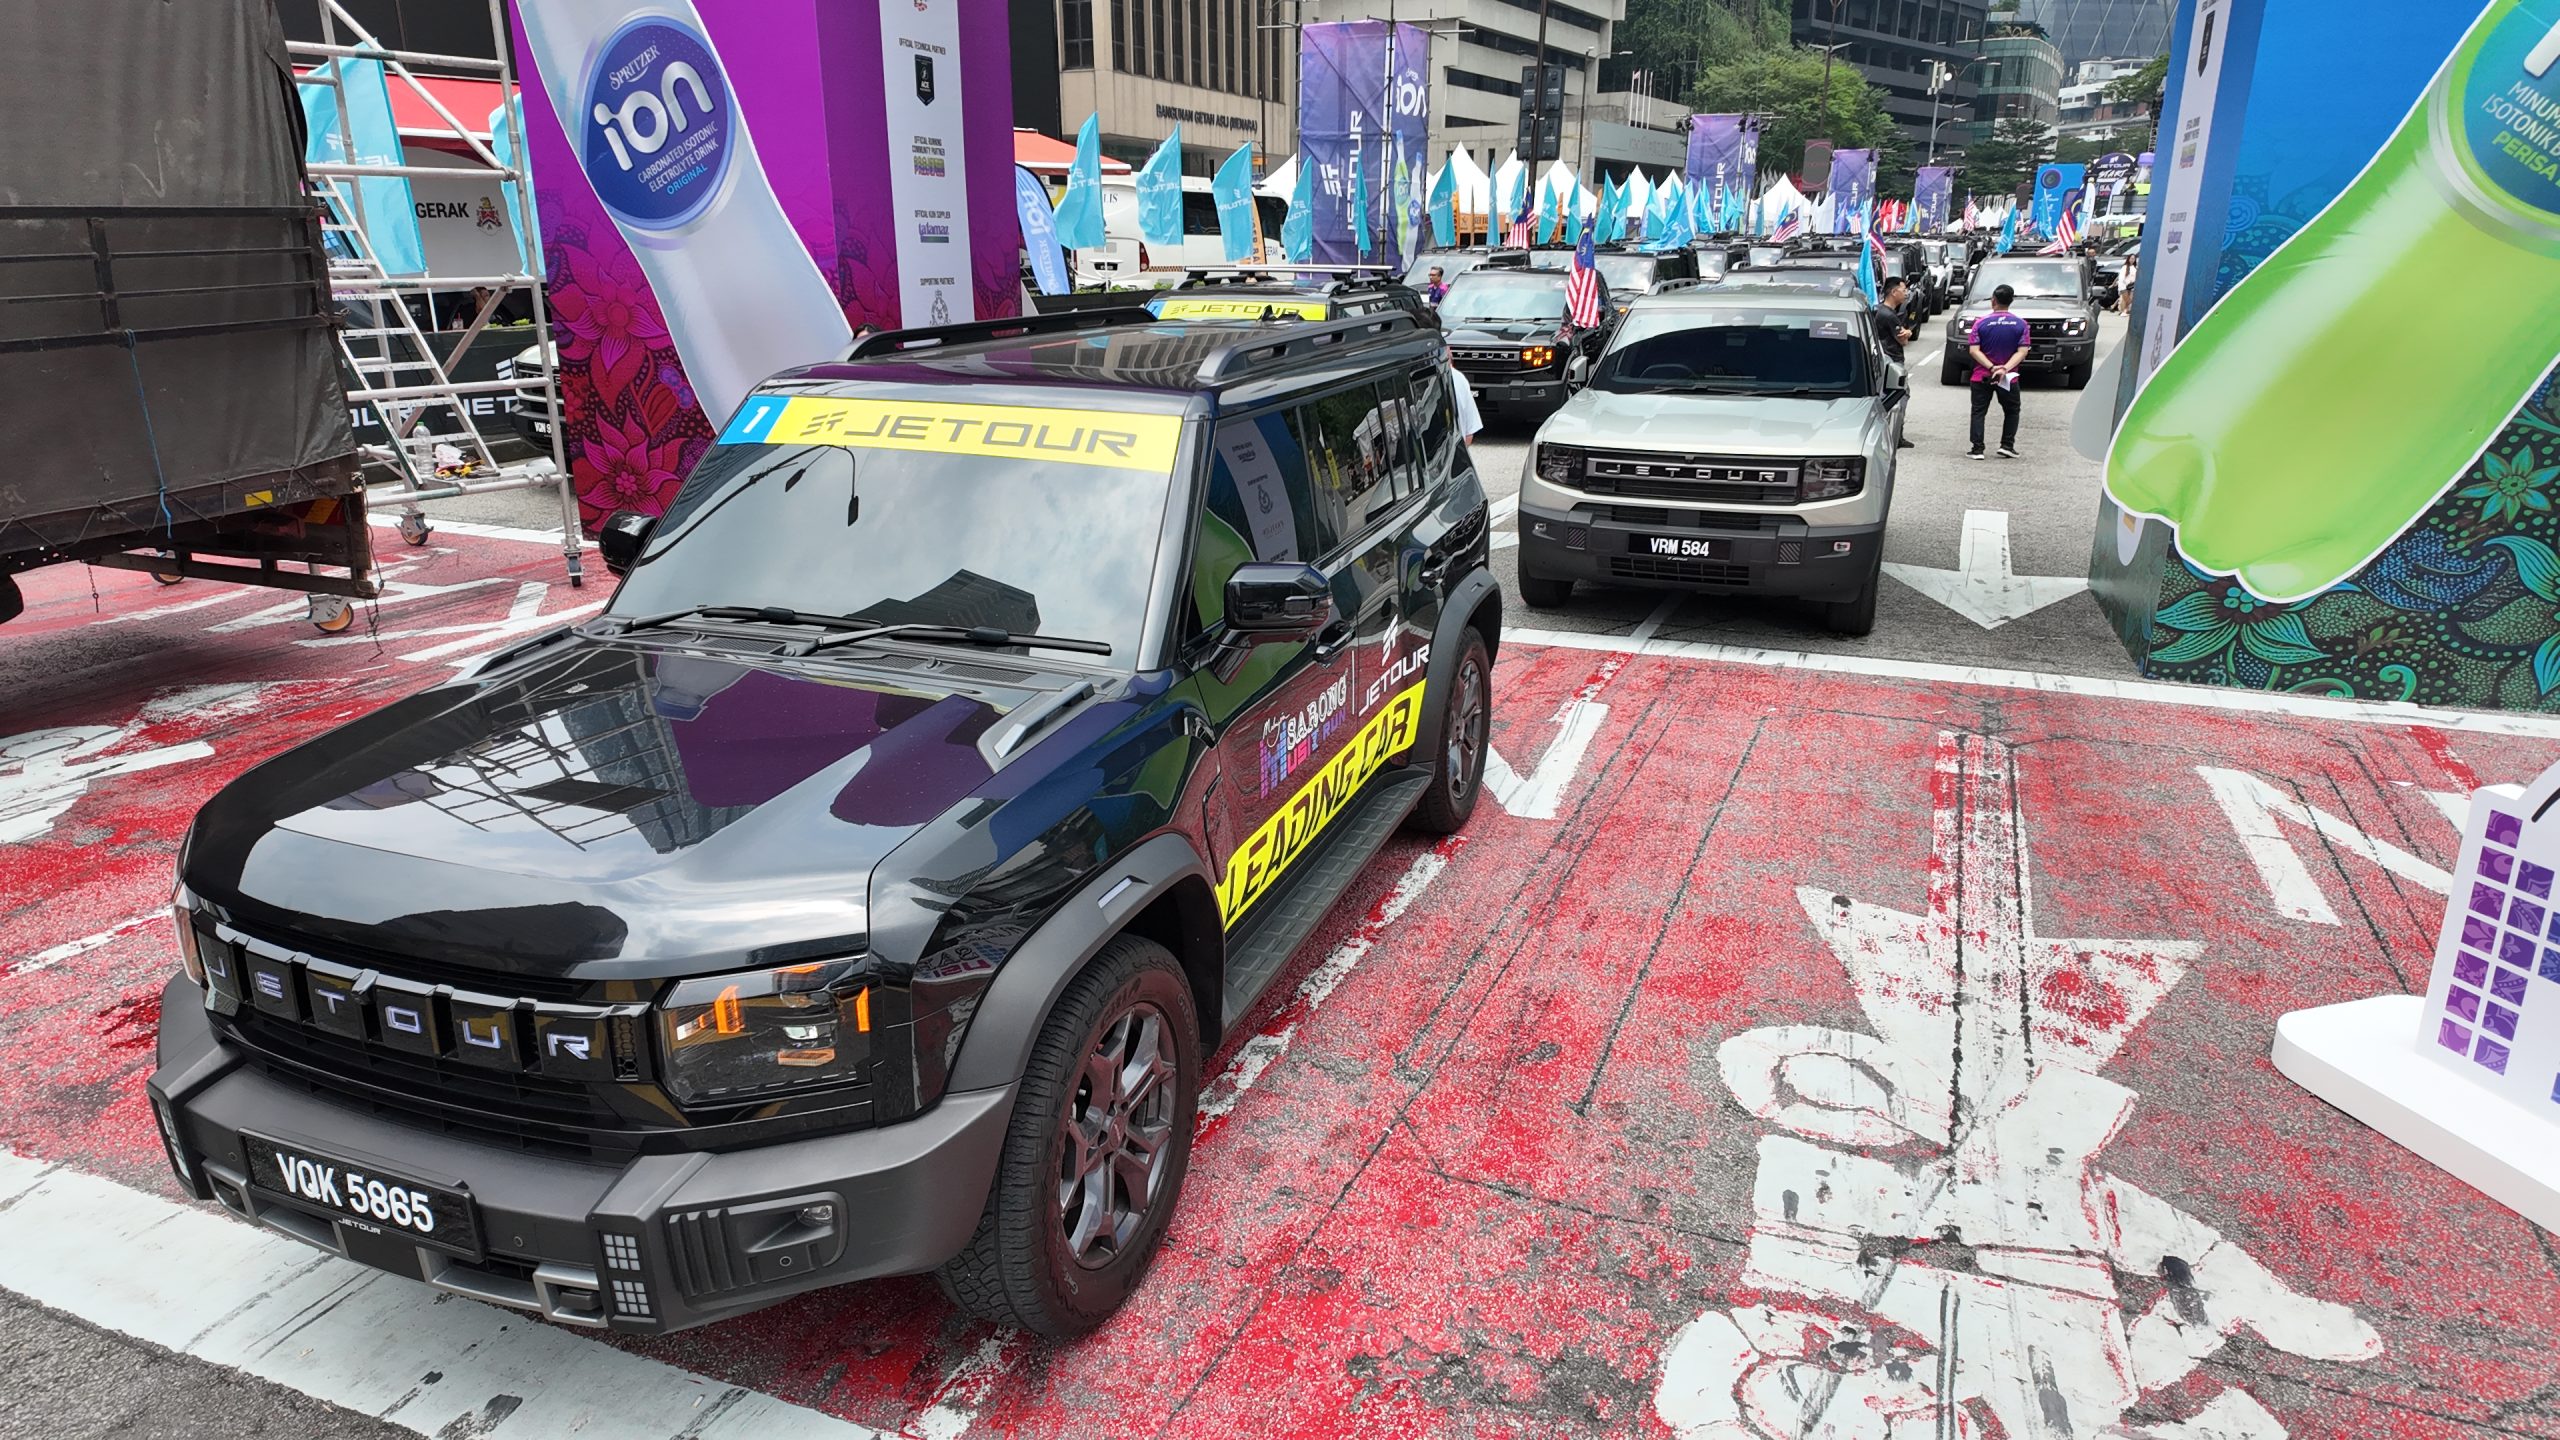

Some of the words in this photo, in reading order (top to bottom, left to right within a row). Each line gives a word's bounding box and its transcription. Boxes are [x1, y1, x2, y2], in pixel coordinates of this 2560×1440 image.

[608, 44, 661, 91] SPRITZER
[593, 60, 715, 172] ion
[1156, 103, 1194, 123] BANGUNAN
[1194, 110, 1215, 127] GETAH
[2481, 93, 2554, 151] ISOTONIK
[637, 143, 686, 184] CARBONATED
[683, 120, 719, 150] ISOTONIC
[648, 154, 697, 193] ELECTROLYTE
[694, 138, 720, 161] DRINK
[666, 163, 708, 196] ORIGINAL
[415, 202, 470, 219] GERAK
[1188, 303, 1301, 315] JETOUR
[1456, 352, 1510, 360] TOUR
[742, 405, 770, 434] 1
[844, 413, 1138, 458] JETOUR
[1605, 463, 1776, 483] JETOUR
[1650, 537, 1679, 555] VRM
[1681, 539, 1710, 557] 584
[1358, 643, 1430, 718] JETOUR
[1321, 708, 1346, 742] RUN
[1226, 743, 1357, 918] LEADING
[1356, 696, 1412, 784] CAR
[207, 955, 591, 1061] JETOUR
[275, 1151, 343, 1208] VQK
[346, 1172, 435, 1234] 5865
[337, 1217, 381, 1236] JETOUR
